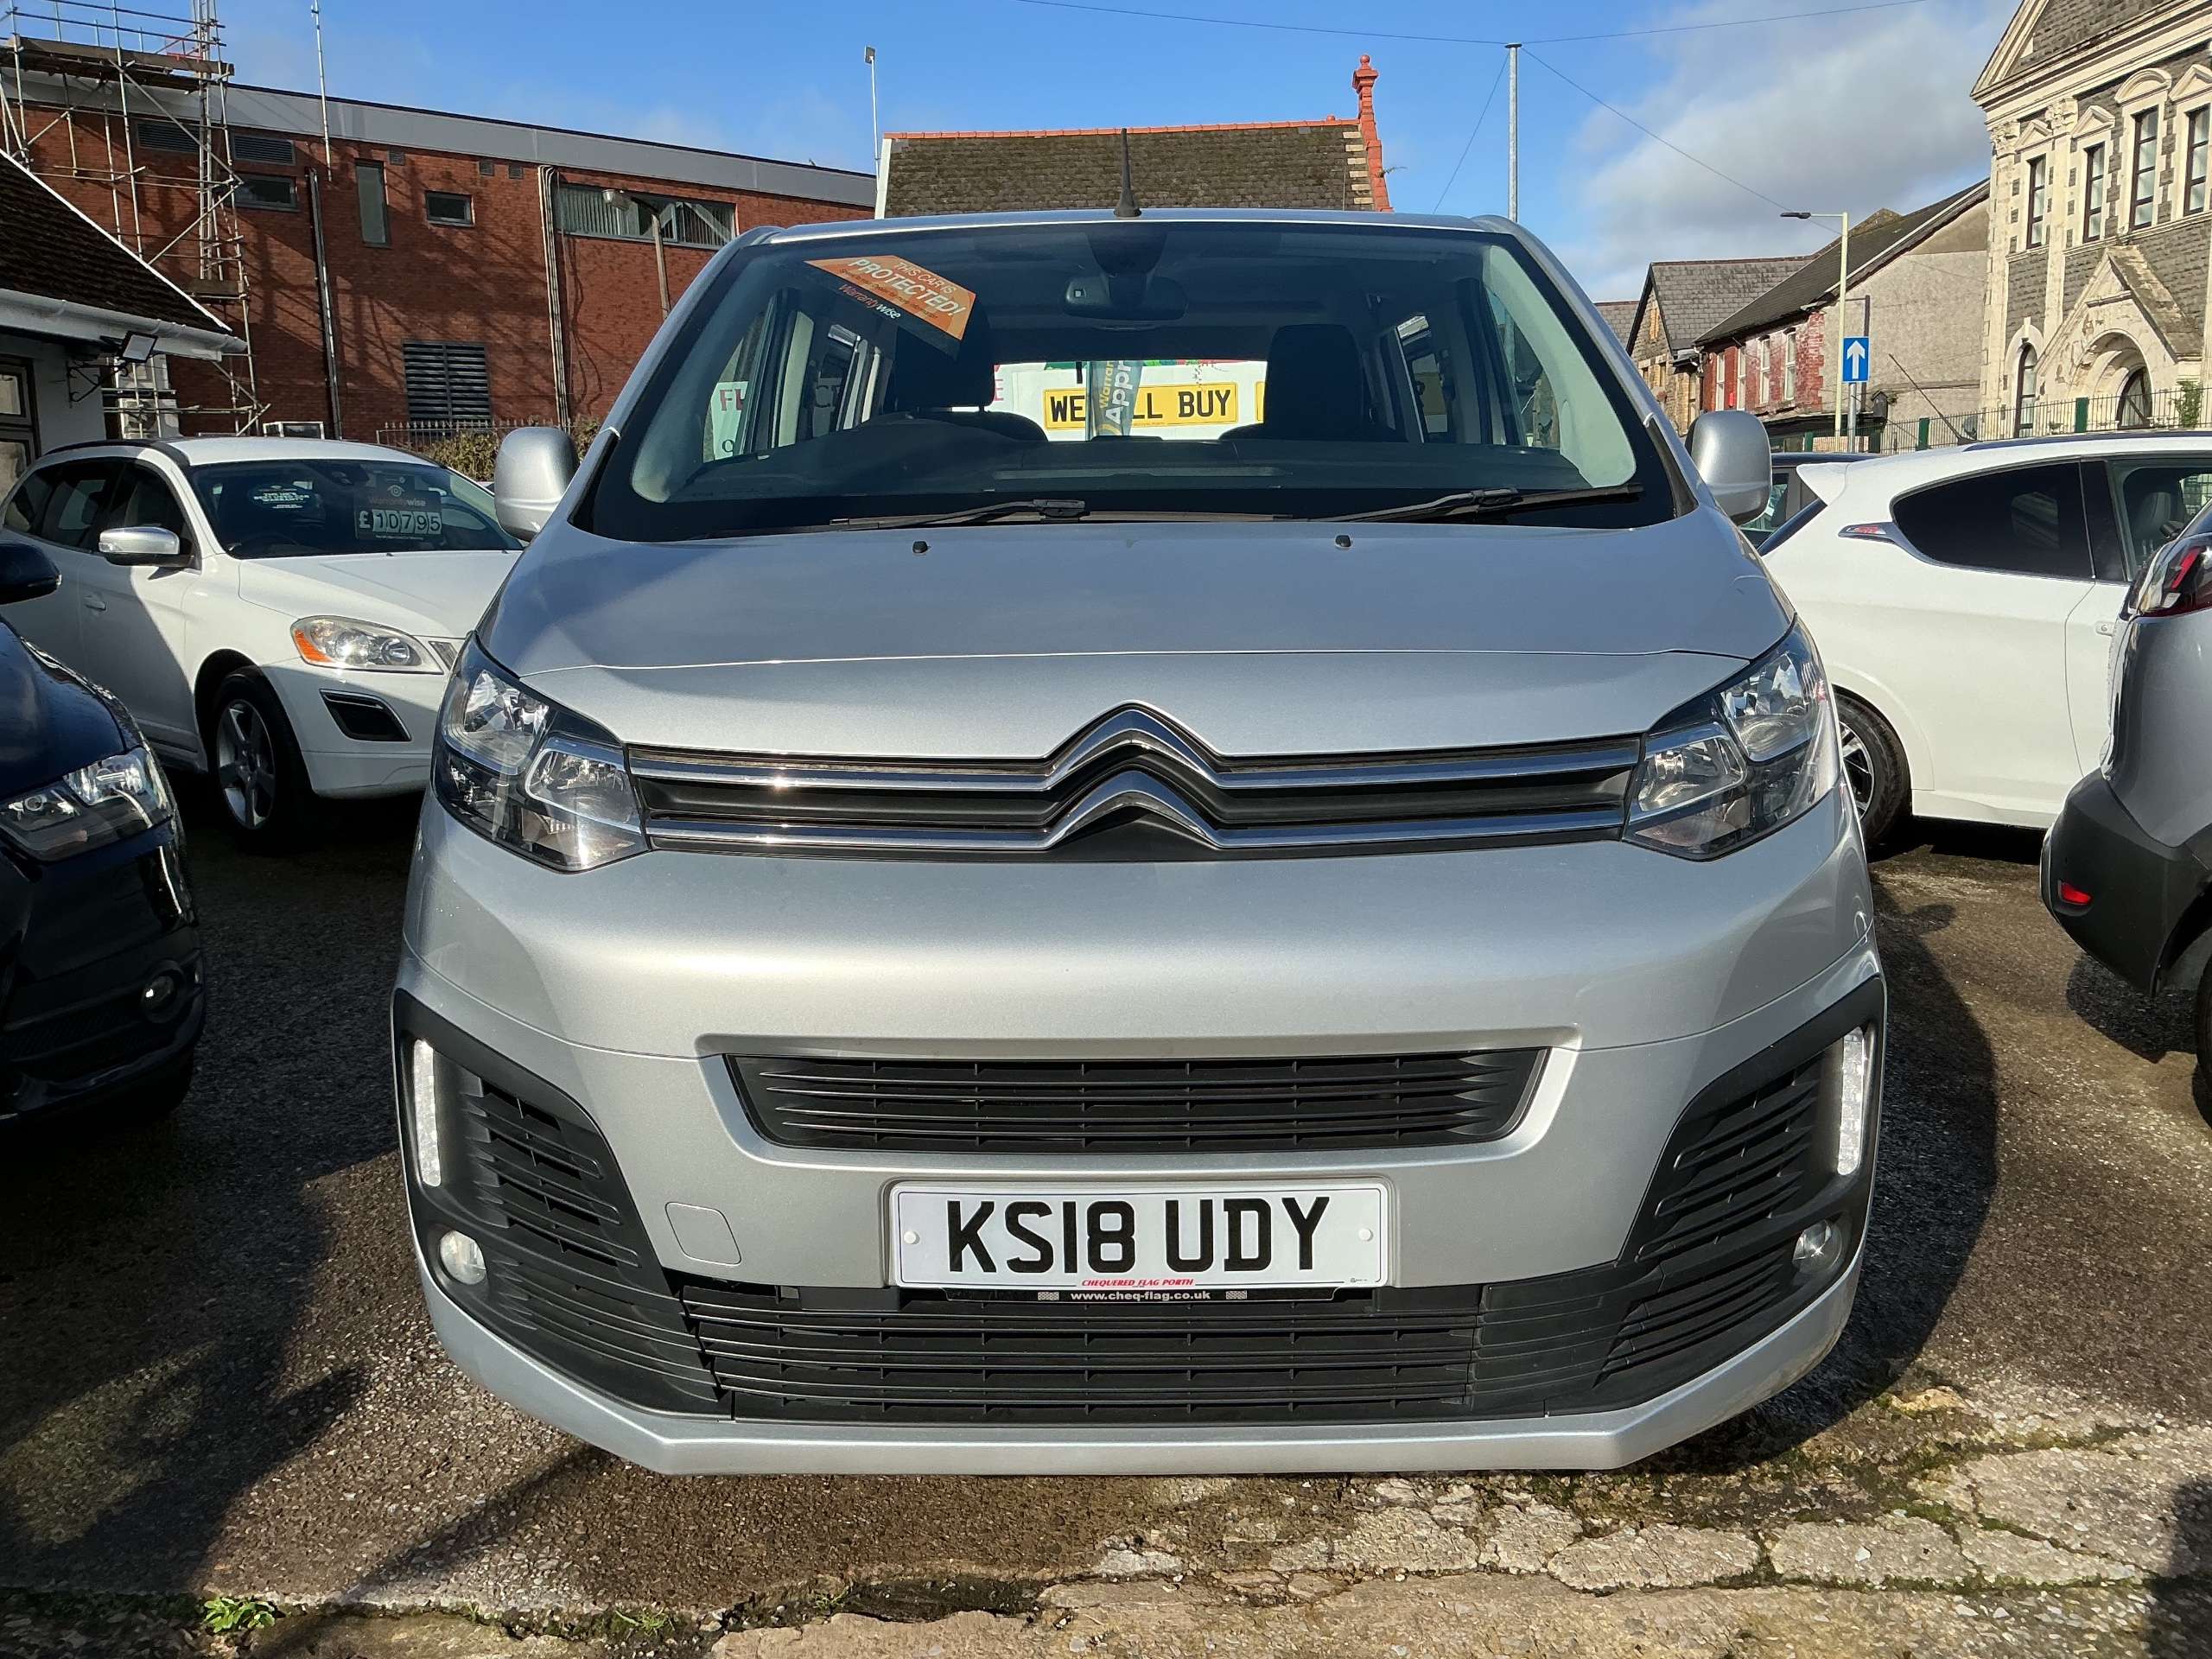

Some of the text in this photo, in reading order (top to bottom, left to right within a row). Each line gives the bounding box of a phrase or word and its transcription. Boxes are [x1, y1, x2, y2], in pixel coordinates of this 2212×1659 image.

[848, 259, 967, 316] PROTECTED!
[895, 262, 957, 294] THIS CAR IS
[1050, 395, 1086, 422] WE
[1178, 389, 1231, 417] BUY
[946, 1197, 1331, 1274] KS18 UDY
[1070, 1290, 1211, 1302] www.cheq-flag.co.uk
